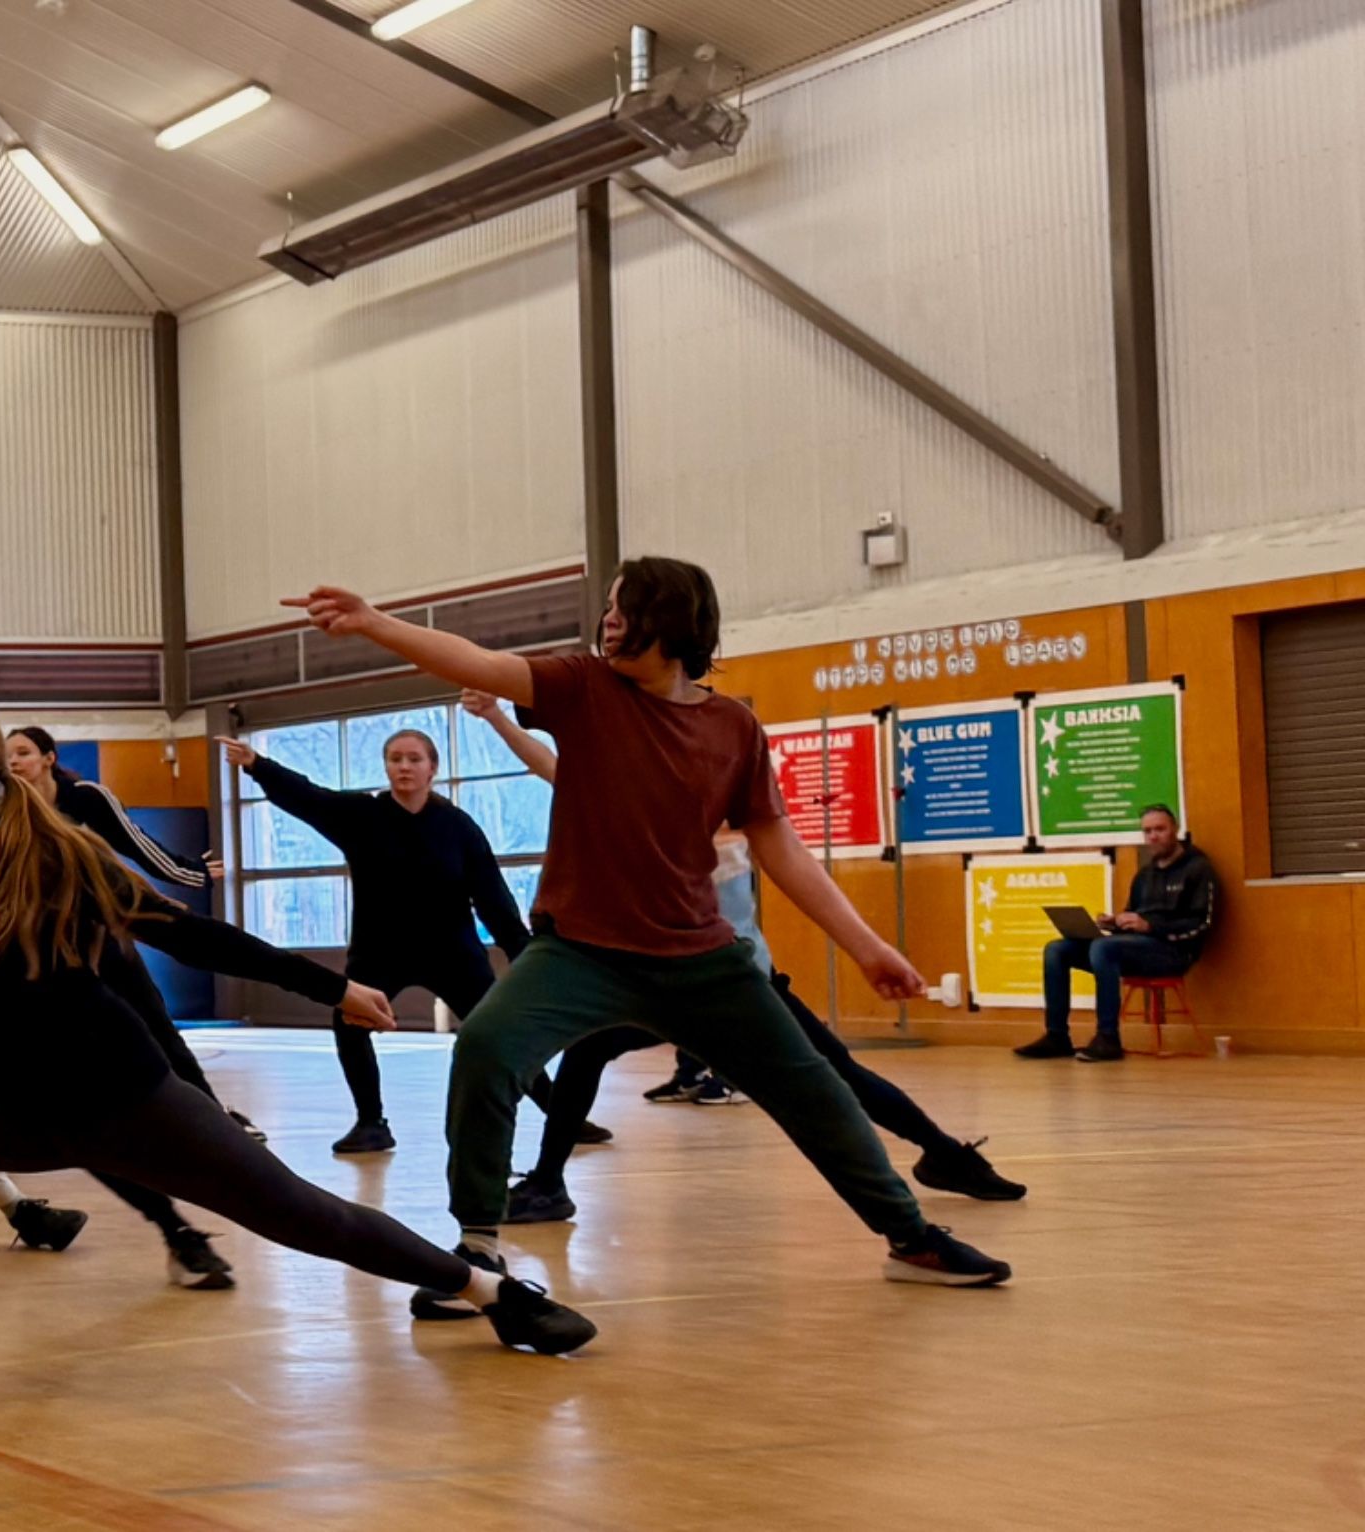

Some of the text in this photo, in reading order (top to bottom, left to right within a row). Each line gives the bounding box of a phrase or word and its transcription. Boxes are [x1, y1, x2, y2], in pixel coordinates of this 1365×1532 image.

[1005, 633, 1085, 667] LEARN
[1064, 703, 1142, 727] BANKSIA
[917, 721, 992, 744] BLUE GUM
